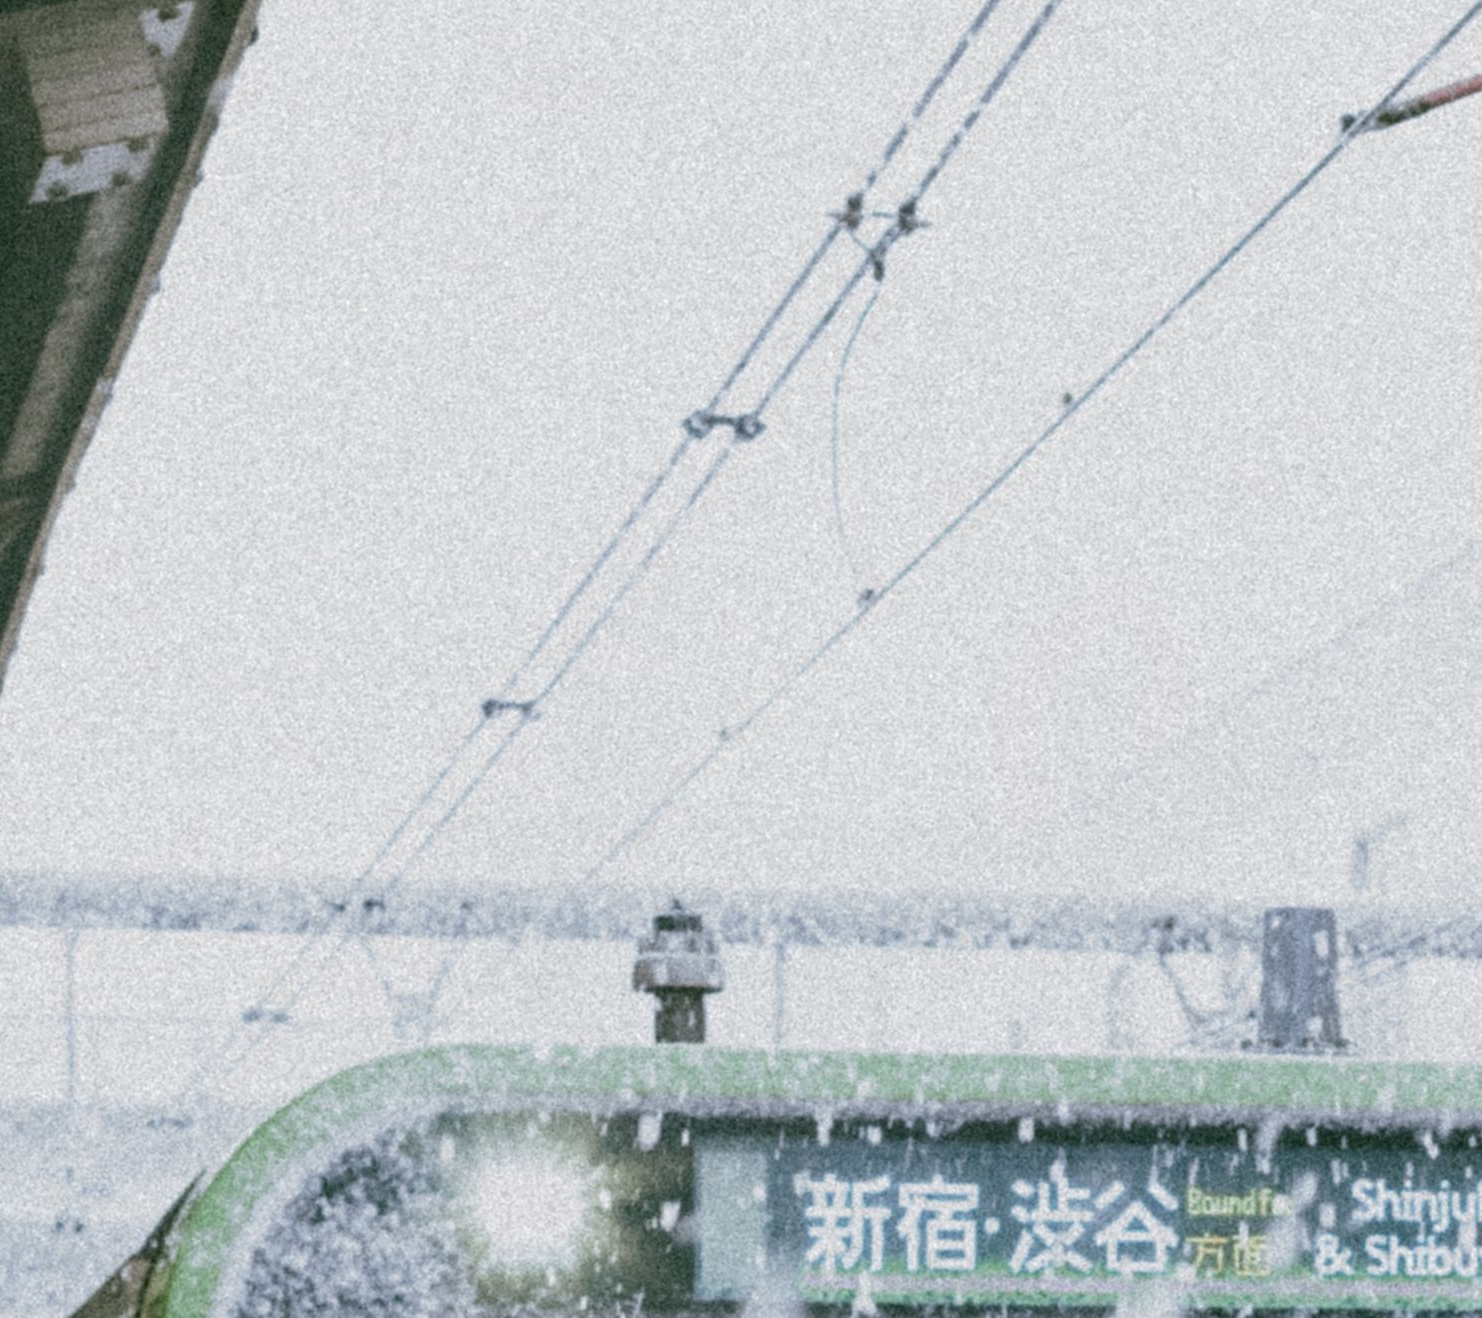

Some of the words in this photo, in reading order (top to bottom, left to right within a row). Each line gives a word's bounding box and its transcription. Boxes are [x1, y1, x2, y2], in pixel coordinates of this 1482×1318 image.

[1187, 1186, 1256, 1215] Bound
[804, 1174, 1179, 1273] 新宿・渋谷
[1185, 1232, 1271, 1276] 方面
[1315, 1233, 1355, 1275] &
